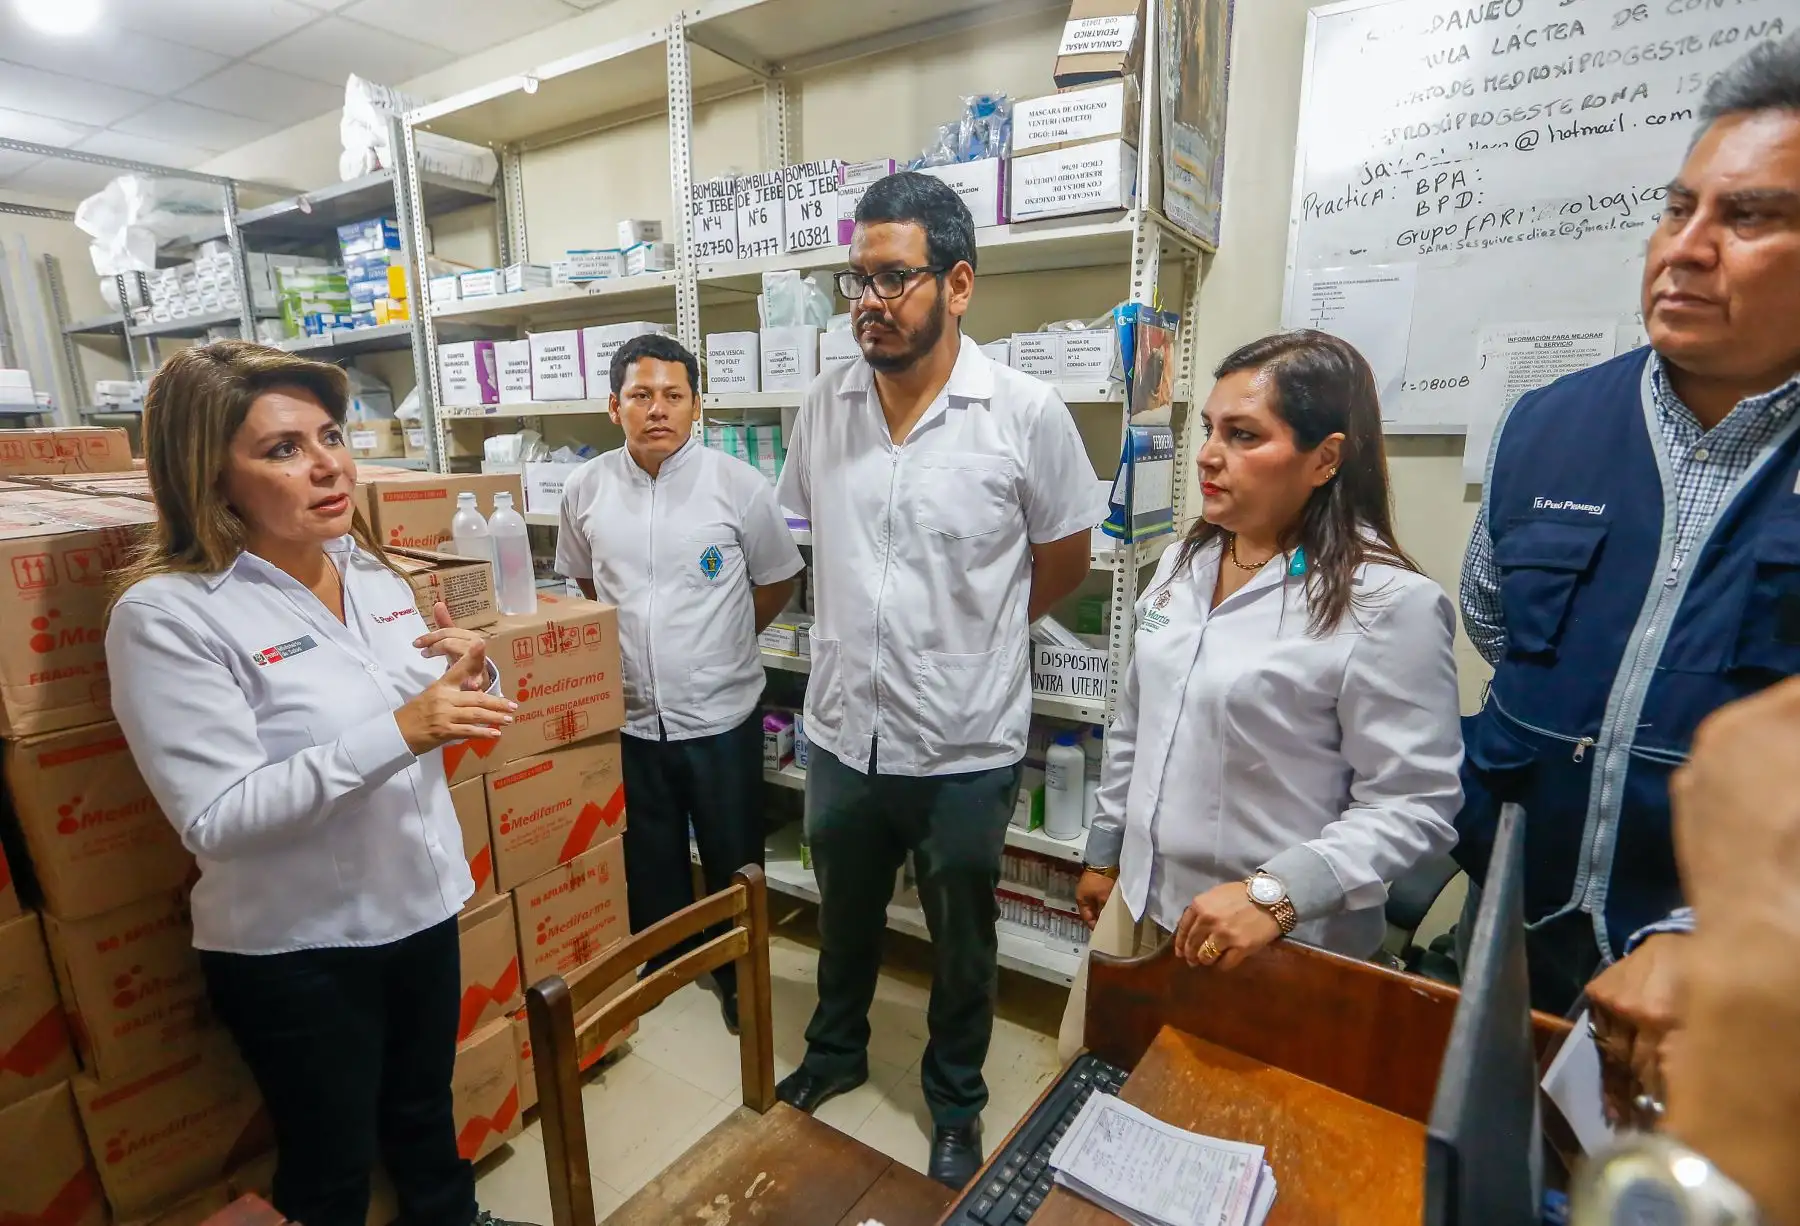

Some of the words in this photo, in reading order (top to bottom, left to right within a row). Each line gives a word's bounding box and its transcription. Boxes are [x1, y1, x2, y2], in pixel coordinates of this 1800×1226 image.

[1073, 28, 1120, 39] PEDIATRICO
[1091, 40, 1123, 48] CANULA
[1029, 108, 1061, 117] MASCARA
[1073, 102, 1107, 111] OXIGENO
[1029, 118, 1057, 127] VENTURI
[785, 159, 839, 182] BOMBILLA
[1058, 170, 1103, 181] RESERVORIO
[692, 180, 735, 200] BOMBILLA
[736, 171, 782, 193] BOMBILLA
[787, 183, 804, 201] DE
[809, 176, 839, 197] JEBE
[738, 192, 750, 208] DE
[755, 185, 784, 204] JEBE
[1024, 196, 1056, 205] OXIGENO
[1067, 190, 1101, 200] MASCARA
[692, 202, 704, 216] DE
[706, 197, 734, 213] JEBE
[790, 225, 831, 249] 10381
[695, 238, 734, 258] 32750
[740, 237, 779, 259] 31777
[1552, 333, 1570, 341] PARA
[1572, 332, 1603, 340] MEJORAR
[530, 671, 605, 699] Medifarma
[1033, 673, 1063, 692] INTRA
[515, 709, 545, 724] FRAGIL
[546, 691, 611, 716] MEDICAMENTOS
[511, 797, 573, 831] Medifarma
[547, 899, 612, 938] Medifarma
